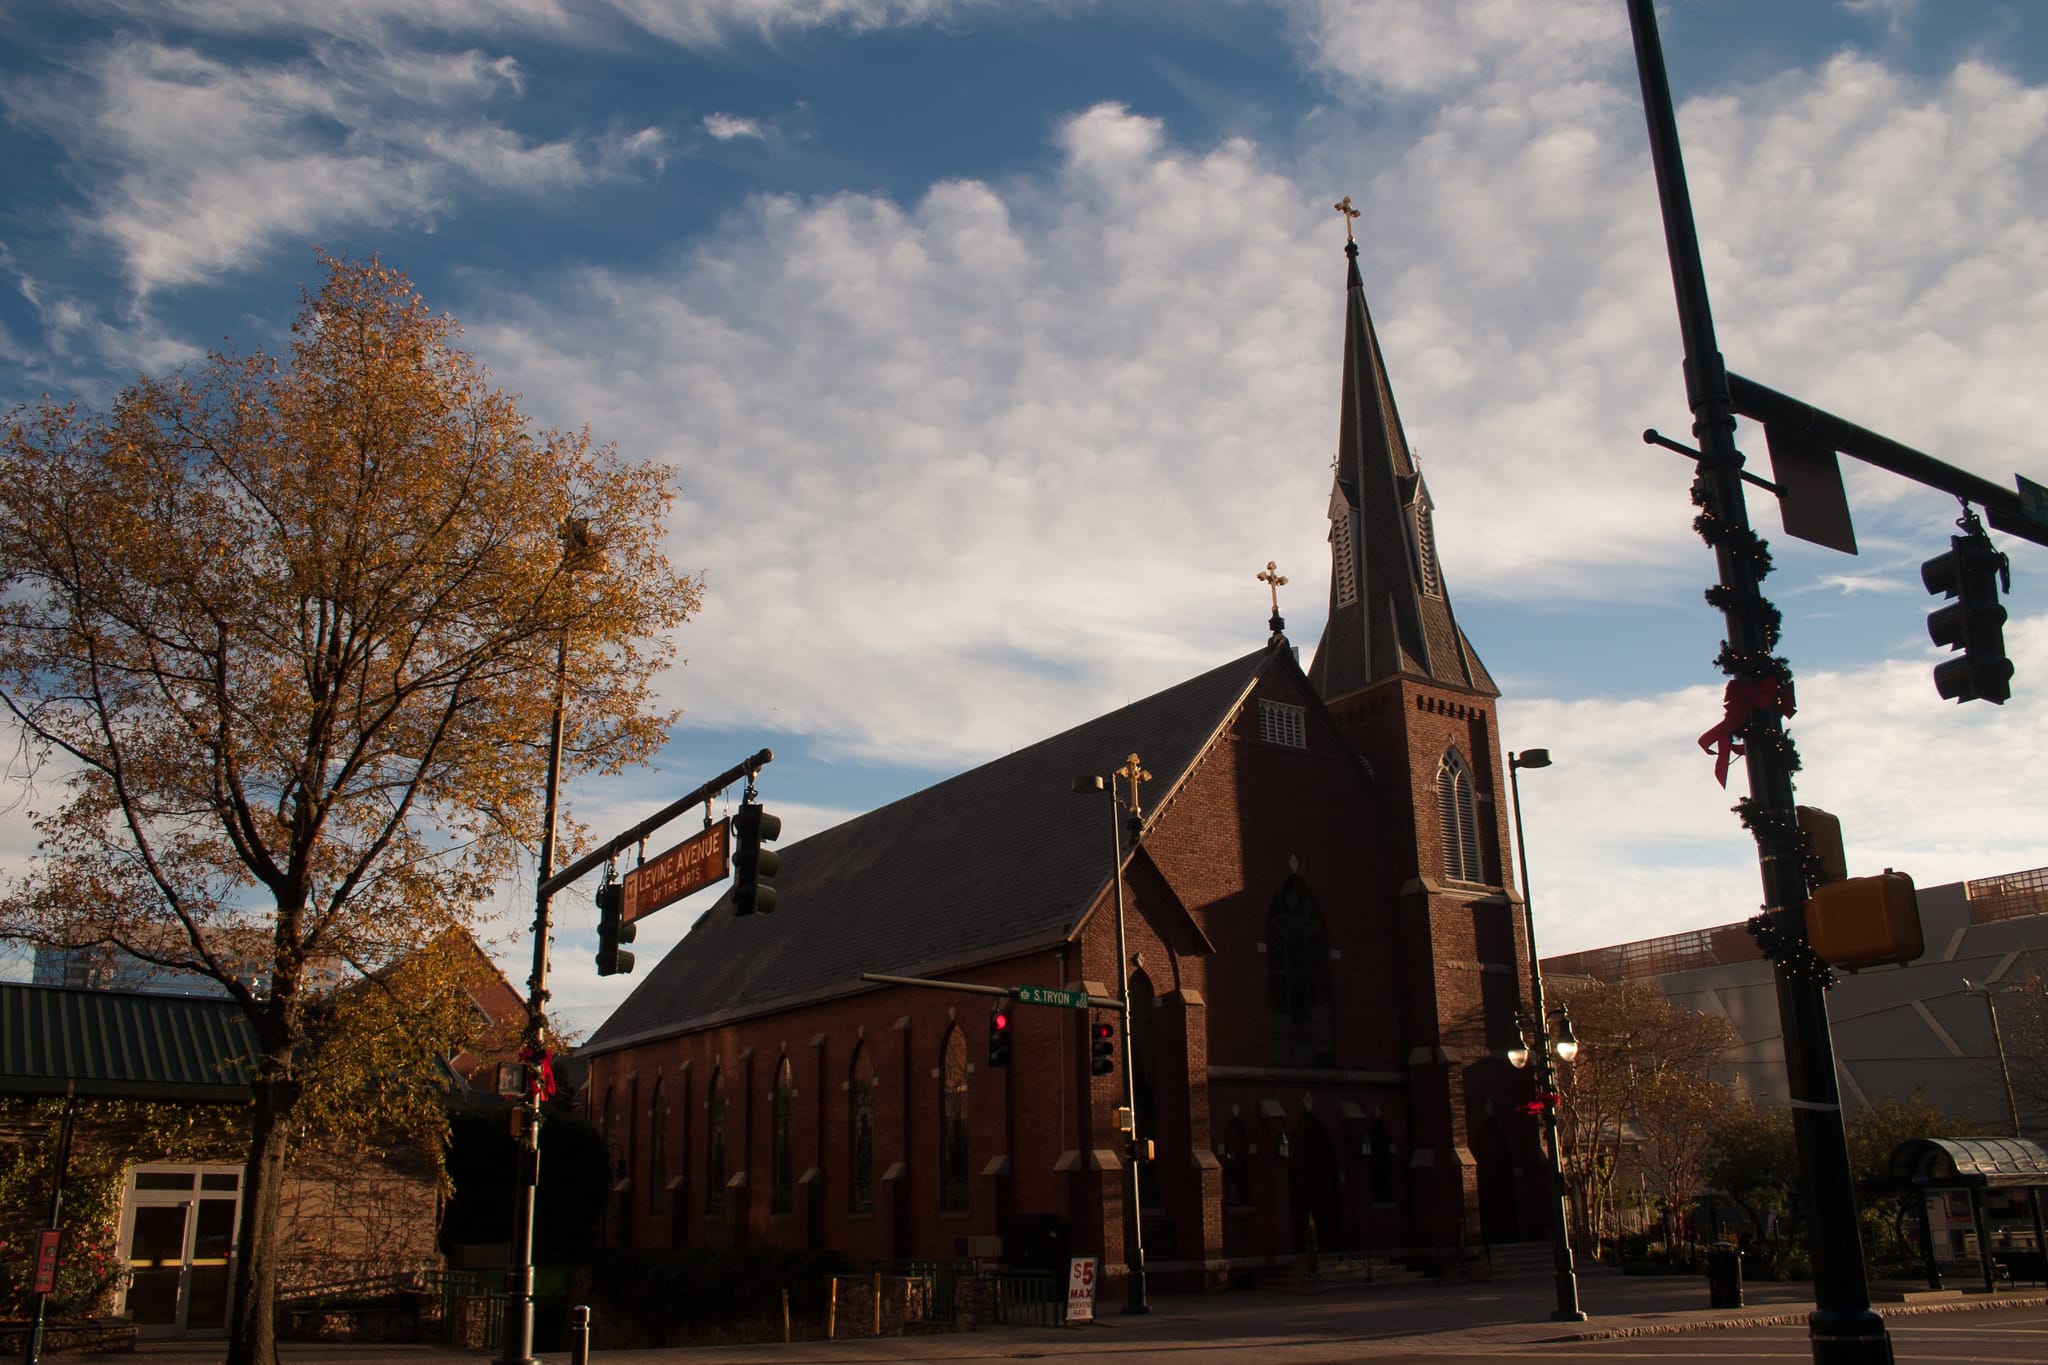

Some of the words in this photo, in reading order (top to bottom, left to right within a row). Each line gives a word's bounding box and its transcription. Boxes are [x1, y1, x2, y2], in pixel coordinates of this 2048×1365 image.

[639, 857, 673, 892] LEVINE
[676, 832, 720, 872] AVENUE
[652, 887, 662, 902] OF
[664, 878, 678, 896] THE
[680, 867, 701, 889] ARTS
[1043, 990, 1070, 1005] TRYON
[1073, 1262, 1094, 1285] $5
[1070, 1289, 1093, 1299] MAX
